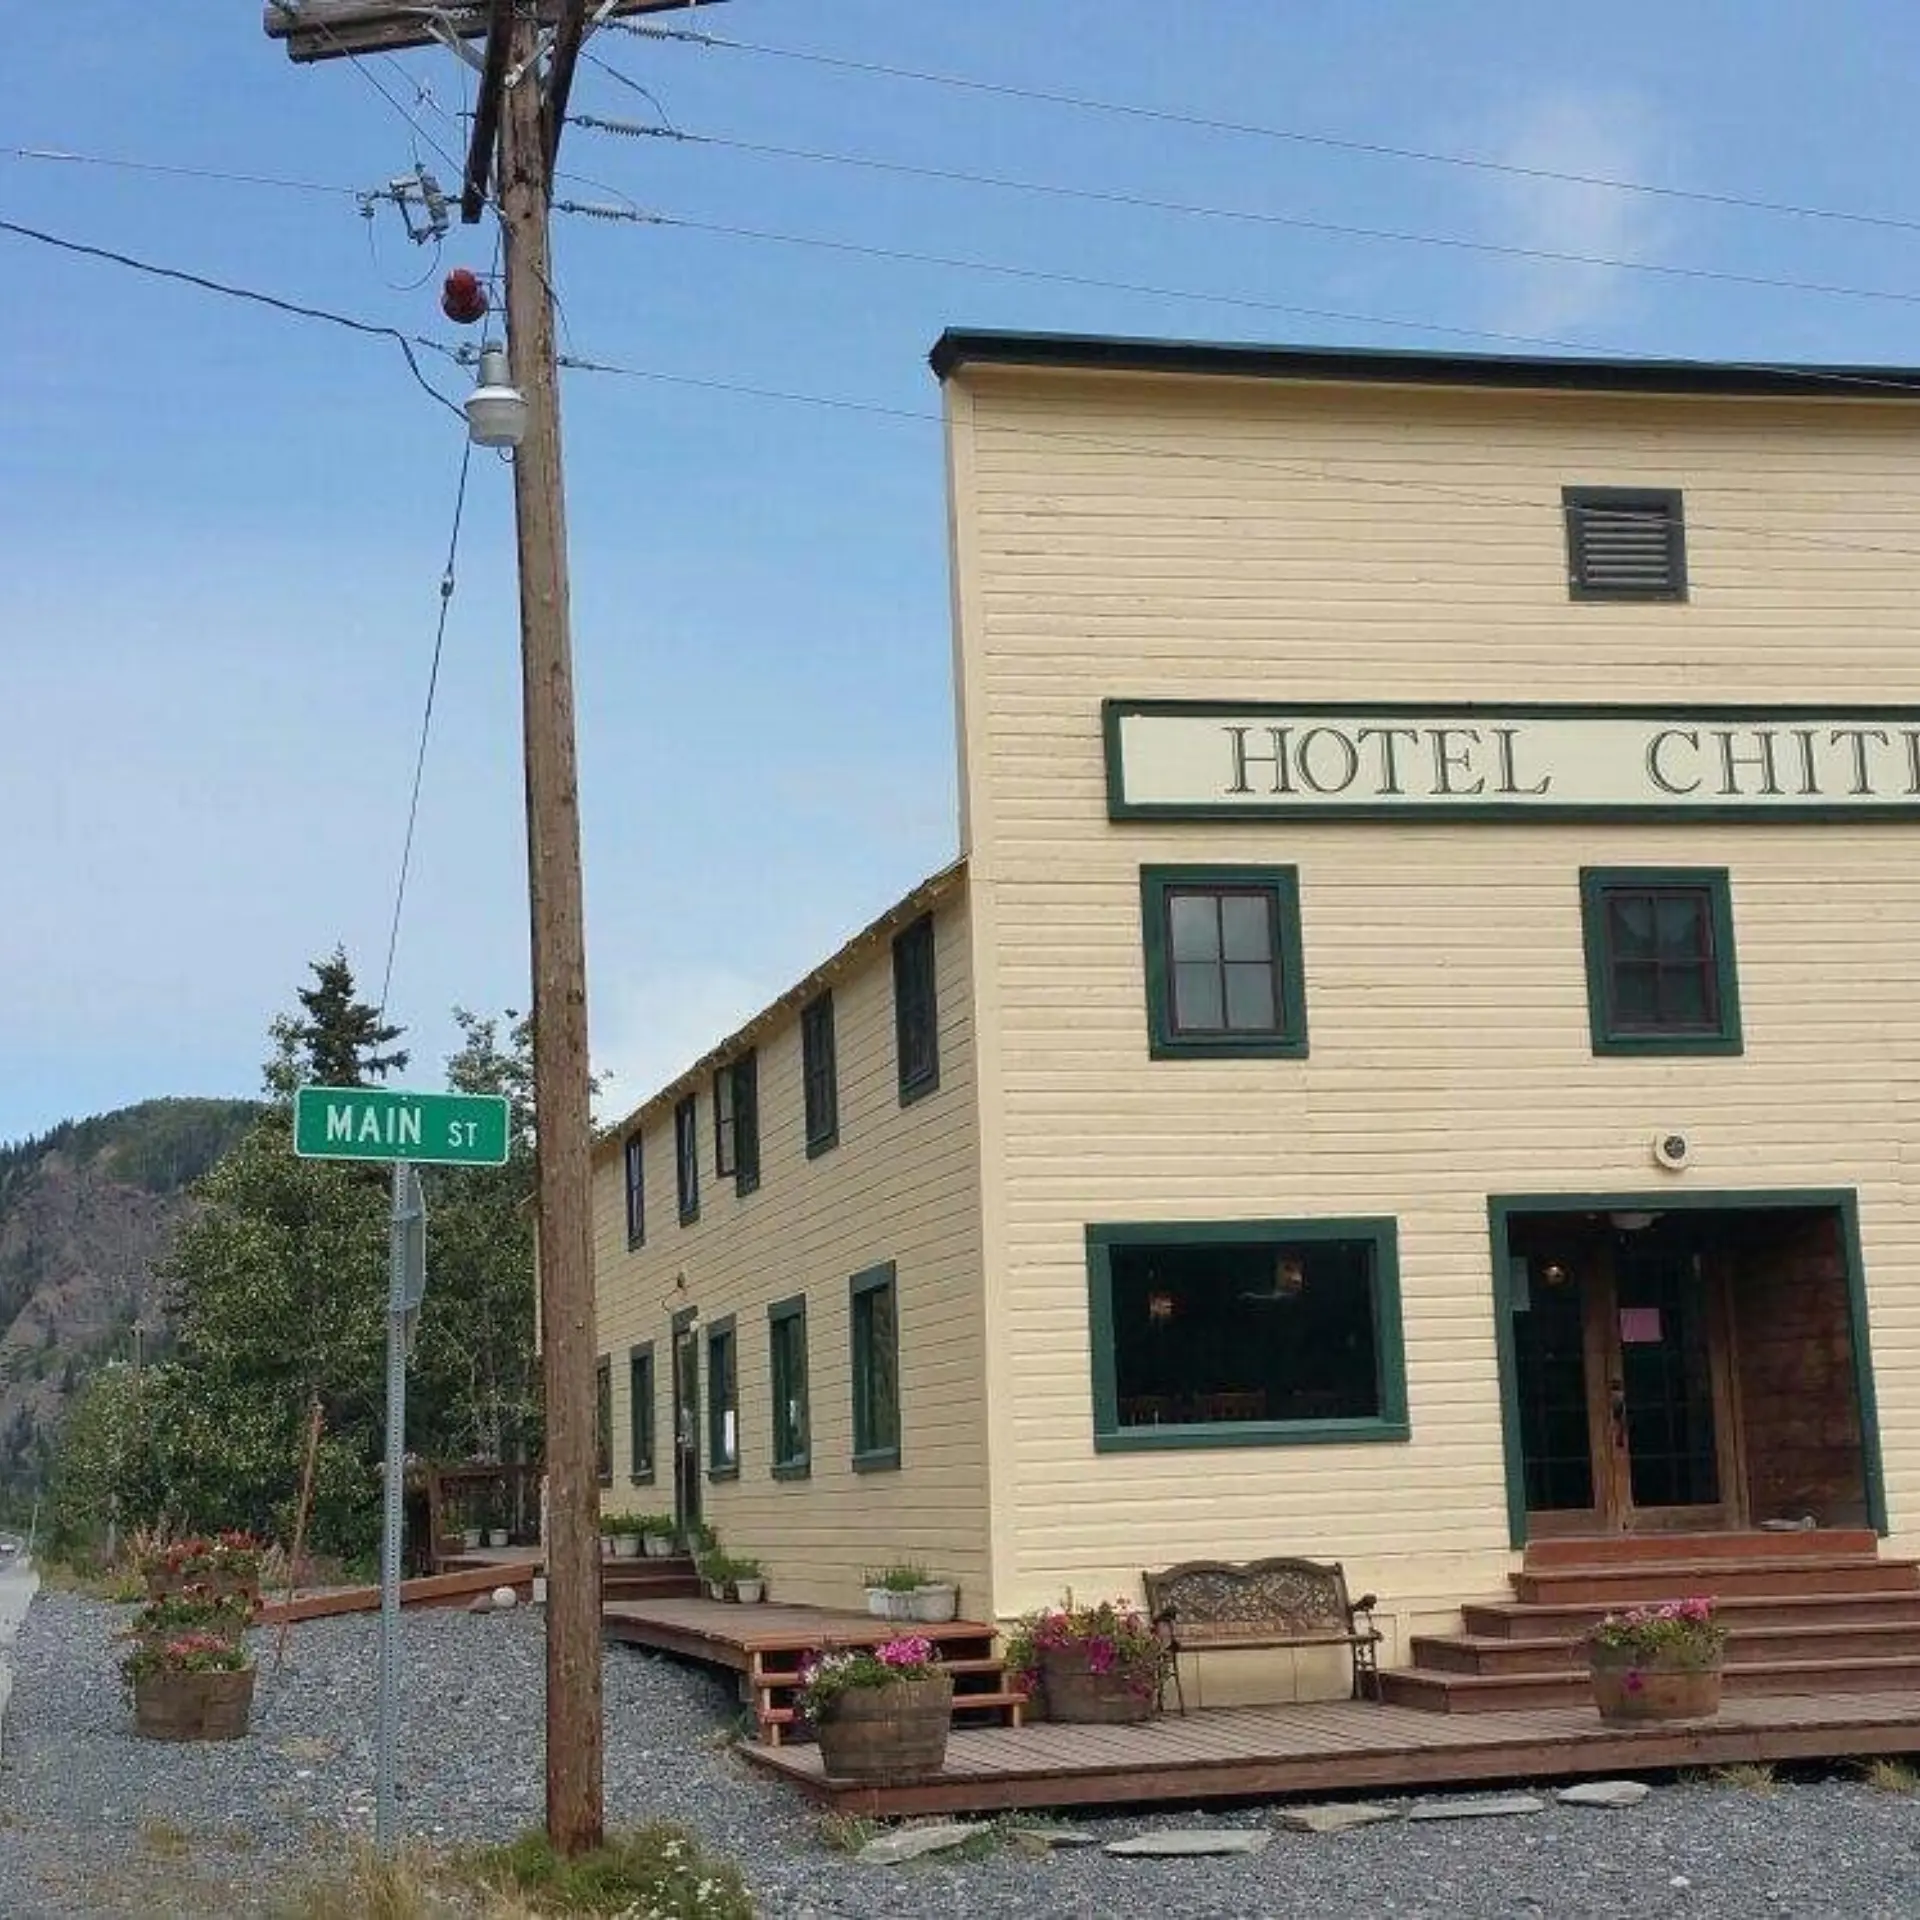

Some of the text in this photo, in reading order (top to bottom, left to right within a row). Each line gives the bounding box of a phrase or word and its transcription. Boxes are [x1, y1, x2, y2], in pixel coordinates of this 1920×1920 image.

[1222, 727, 1552, 795] HOTEL
[326, 1104, 478, 1148] MAIN ST
